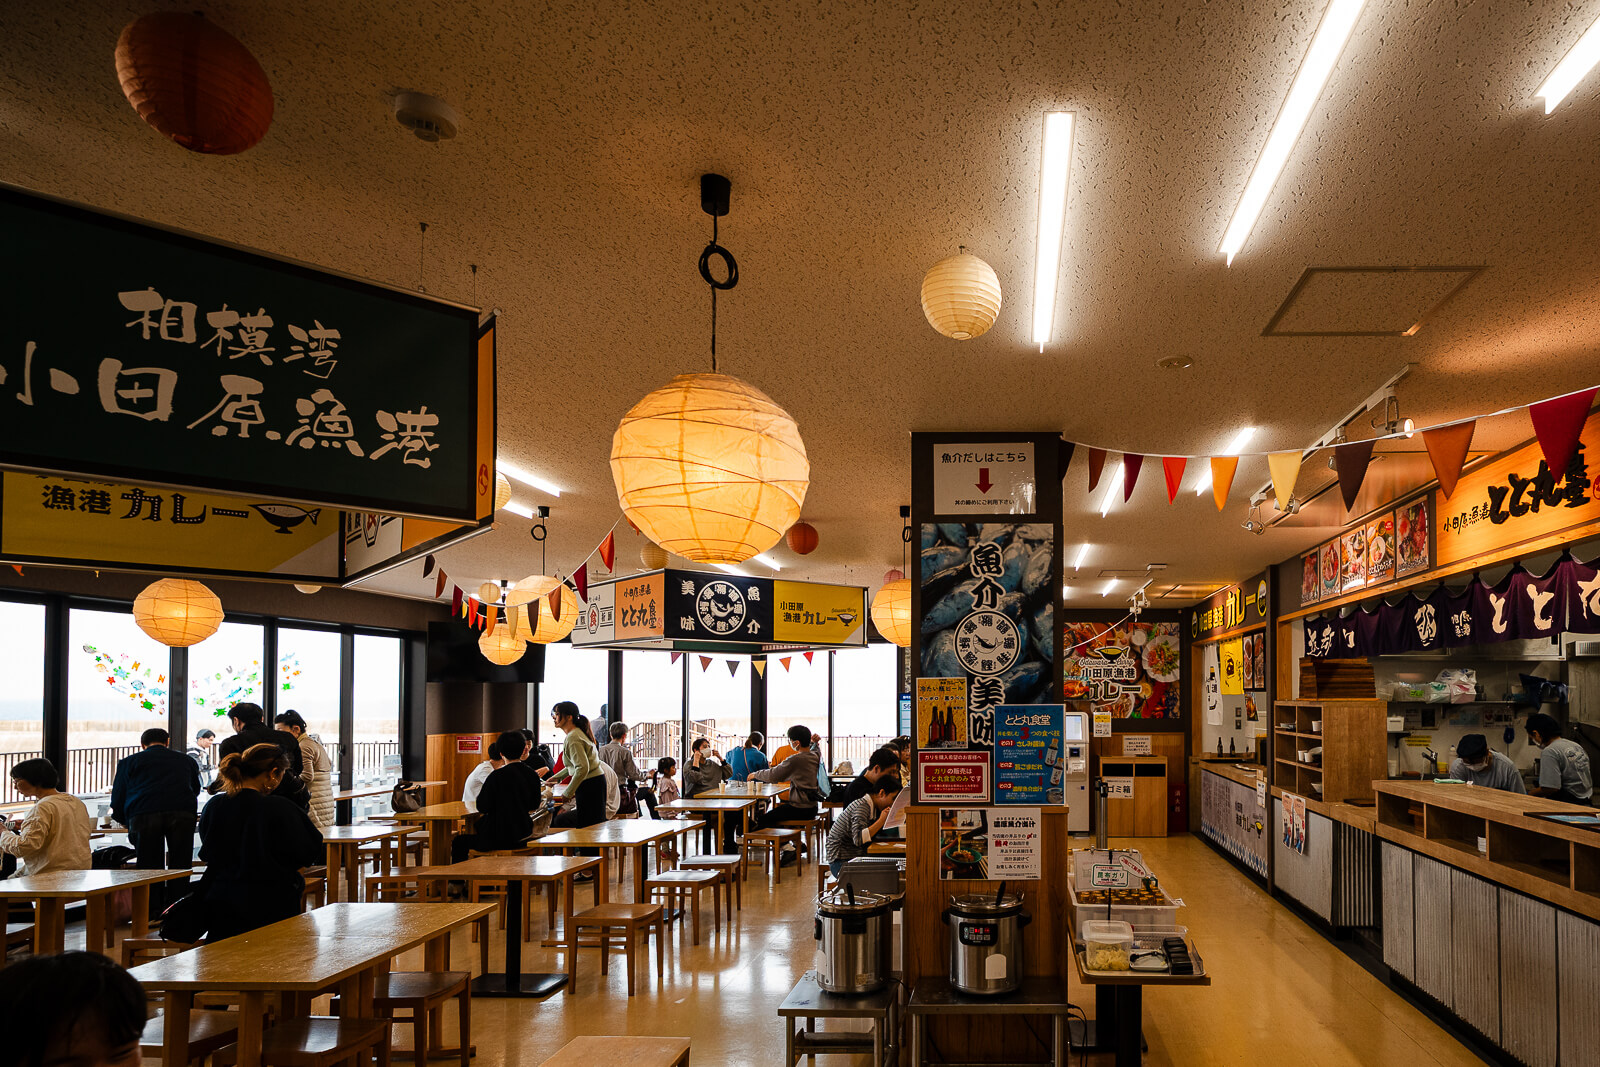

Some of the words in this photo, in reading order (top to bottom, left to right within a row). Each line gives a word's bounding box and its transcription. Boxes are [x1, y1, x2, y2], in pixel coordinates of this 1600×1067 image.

[117, 286, 341, 380] 相模湾
[0, 341, 441, 468] 小田原漁港
[941, 452, 1026, 464] 魚介だしはこちら
[41, 485, 249, 524] 漁港カレー
[970, 543, 1003, 611] 魚介
[780, 601, 804, 612] 小田原
[783, 610, 838, 626] 漁港カレー
[1081, 667, 1136, 678] 小田原漁港
[1005, 714, 1051, 726] とと丸食堂
[1020, 726, 1030, 740] 3
[934, 767, 973, 776] ガリの販売は
[925, 775, 982, 783] とと丸食堂のみです
[1107, 785, 1131, 794] ゴミ箱
[1097, 871, 1125, 879] 昆布ガリ
